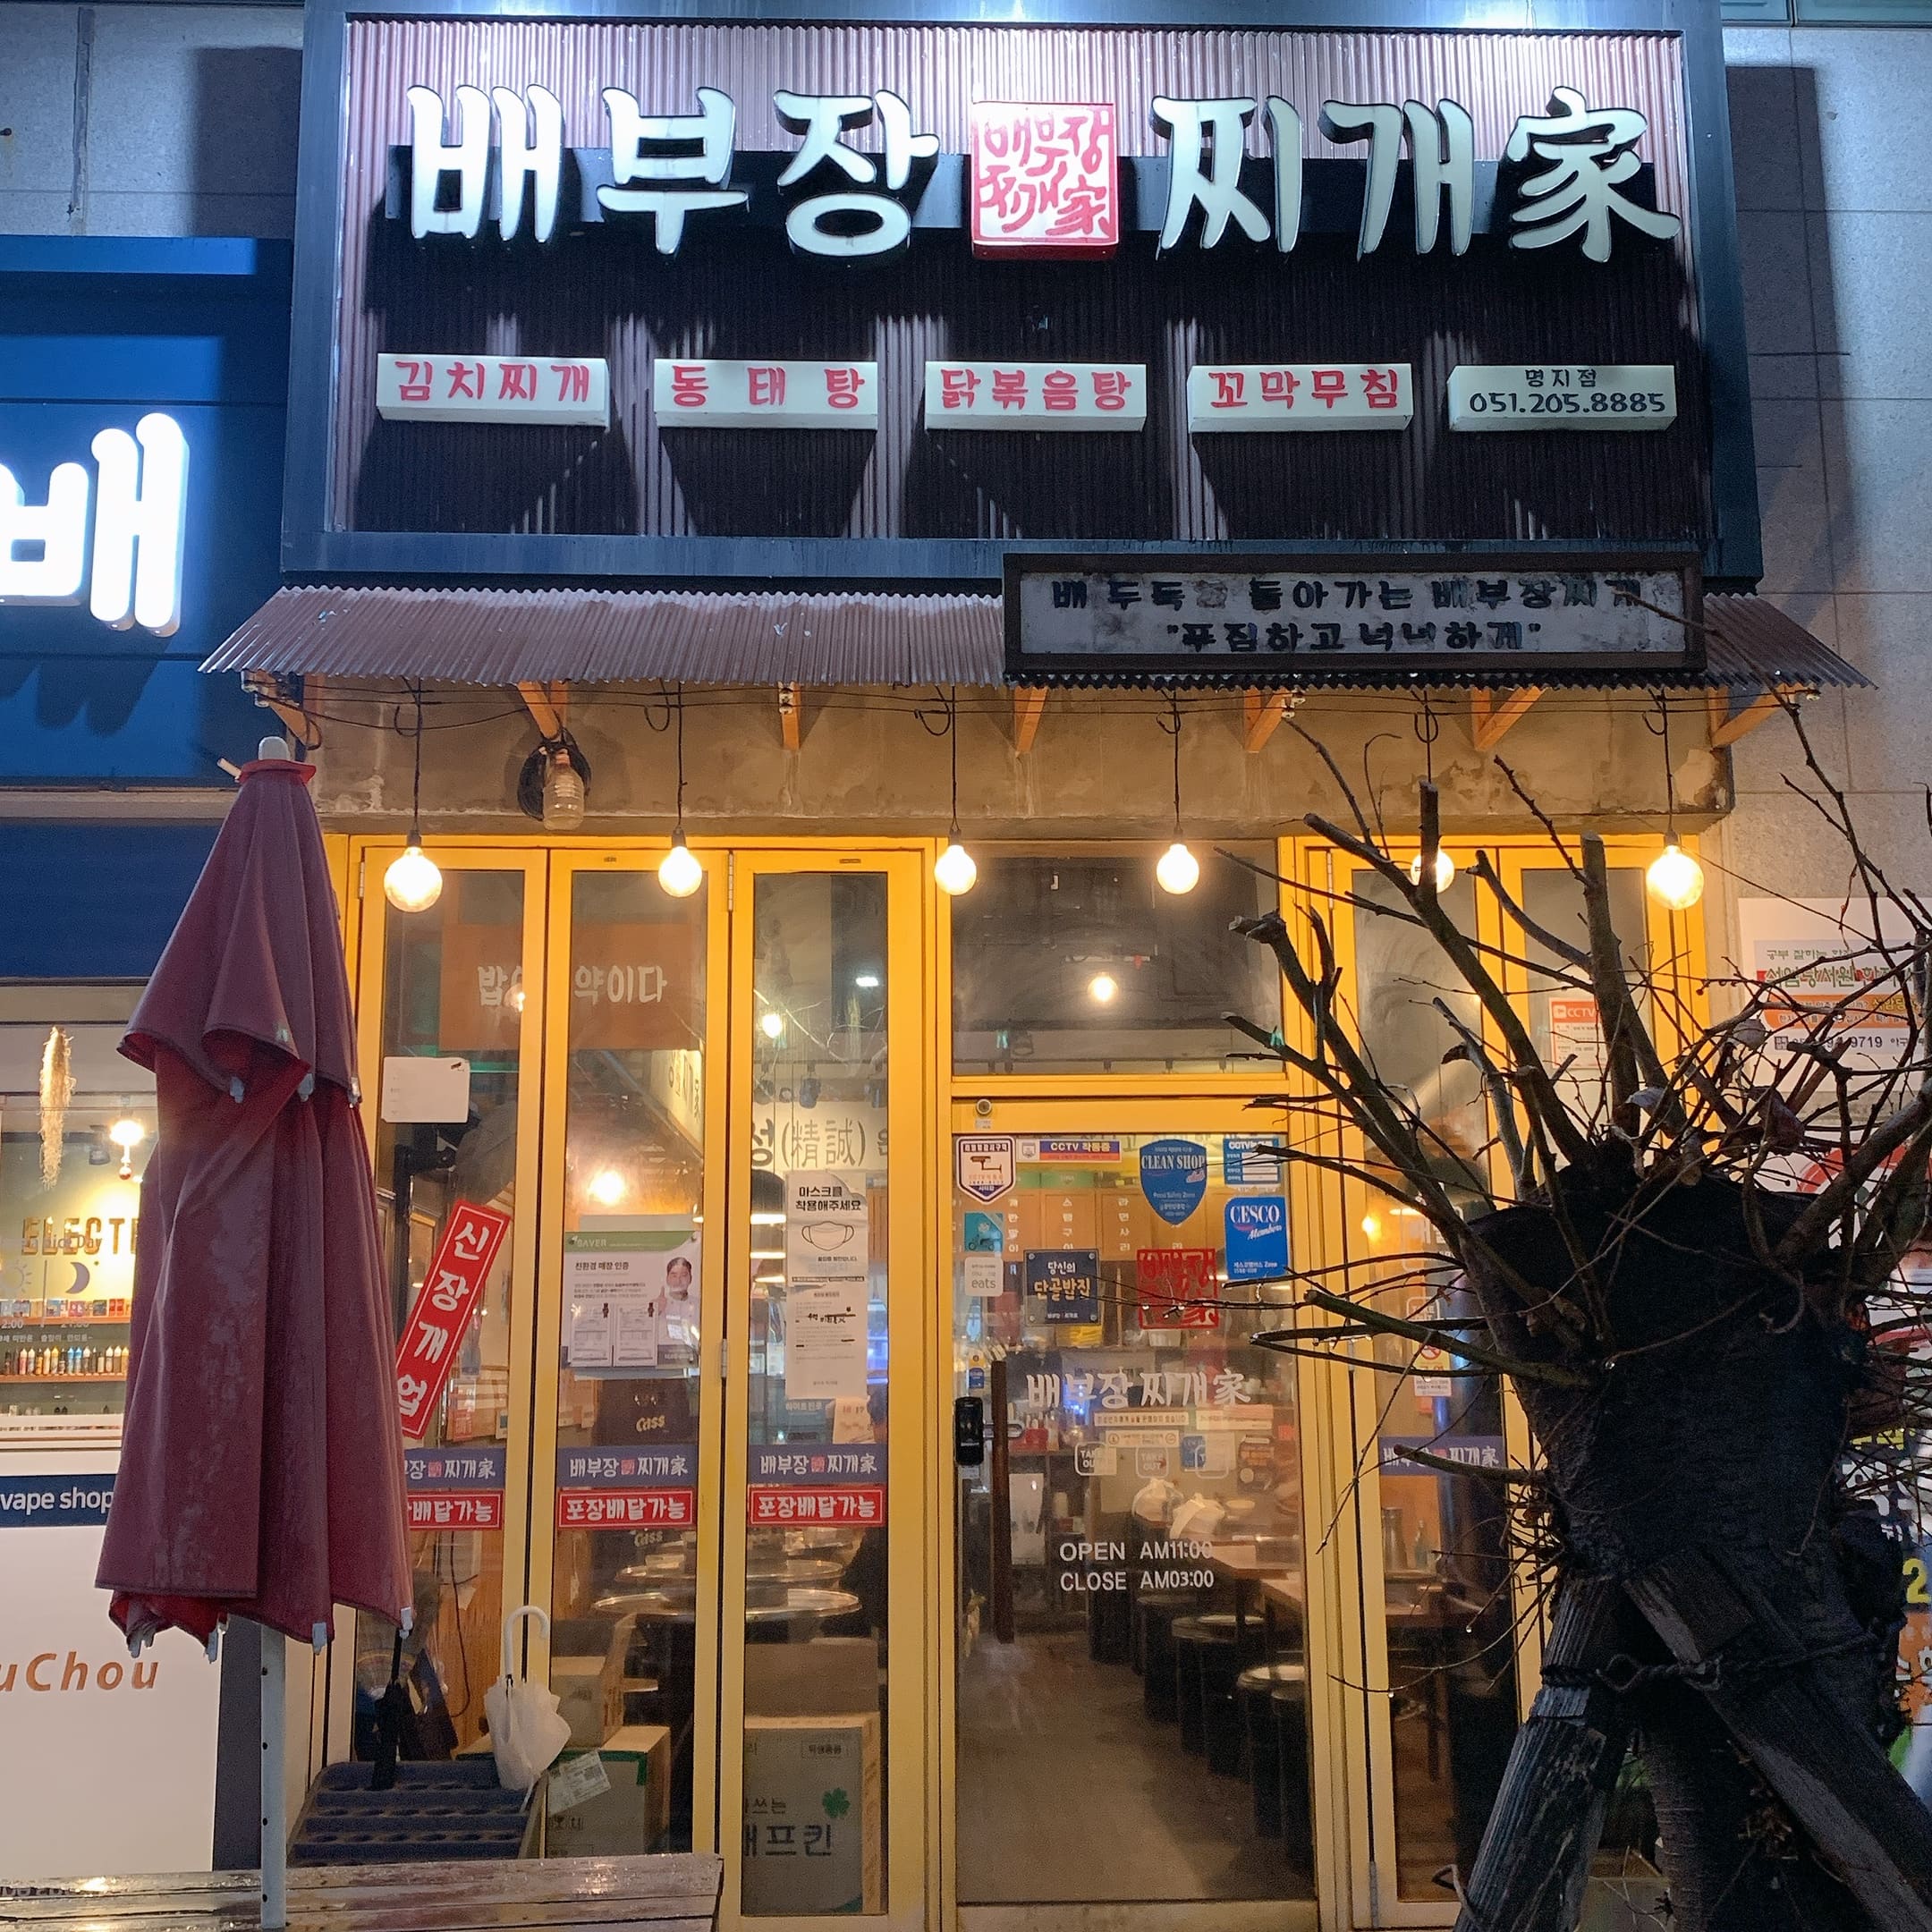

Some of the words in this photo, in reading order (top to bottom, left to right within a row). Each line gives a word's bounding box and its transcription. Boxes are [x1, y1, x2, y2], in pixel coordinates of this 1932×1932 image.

[406, 84, 941, 256] 배부장
[1151, 86, 1682, 263] 찌개家
[394, 360, 590, 403] 김치찌개
[671, 364, 867, 410] 동태탕
[941, 368, 1132, 411] 닭볶음탕
[1208, 368, 1401, 411] 꼬막무침
[1525, 369, 1597, 388] 명지점
[1469, 392, 1666, 414] 051.205.8885
[0, 413, 190, 637] 배
[1052, 580, 1089, 610] 배
[574, 964, 668, 1005] 약이다
[1050, 1141, 1080, 1151] CCTV
[1141, 1155, 1175, 1170] CLEAN
[1176, 1154, 1206, 1170] SHOP
[799, 1186, 843, 1198] 마스크를
[796, 1199, 861, 1211] 착용해주세요
[1230, 1204, 1280, 1224] CESCO
[1047, 1260, 1076, 1275] 당신의
[971, 1278, 996, 1289] eats
[396, 1221, 490, 1418] 신장개업
[1026, 1372, 1134, 1410] 배부장
[636, 1415, 666, 1432] Cass
[444, 1456, 496, 1479] 찌개家
[570, 1457, 620, 1478] 배부장
[638, 1455, 688, 1477] 찌개家
[759, 1454, 810, 1477] 배부장
[826, 1452, 877, 1475] 찌개家
[0, 1491, 55, 1515] vape
[59, 1487, 114, 1513] shop
[407, 1499, 493, 1522] 배달가능
[566, 1497, 686, 1521] 포장배달가능
[758, 1495, 877, 1520] 포장배달가능
[634, 1530, 664, 1547] Cass
[1059, 1541, 1126, 1562] OPEN
[1140, 1540, 1214, 1560] AM11:00
[1060, 1571, 1127, 1591] CLOSE
[1140, 1570, 1215, 1589] AM03:00
